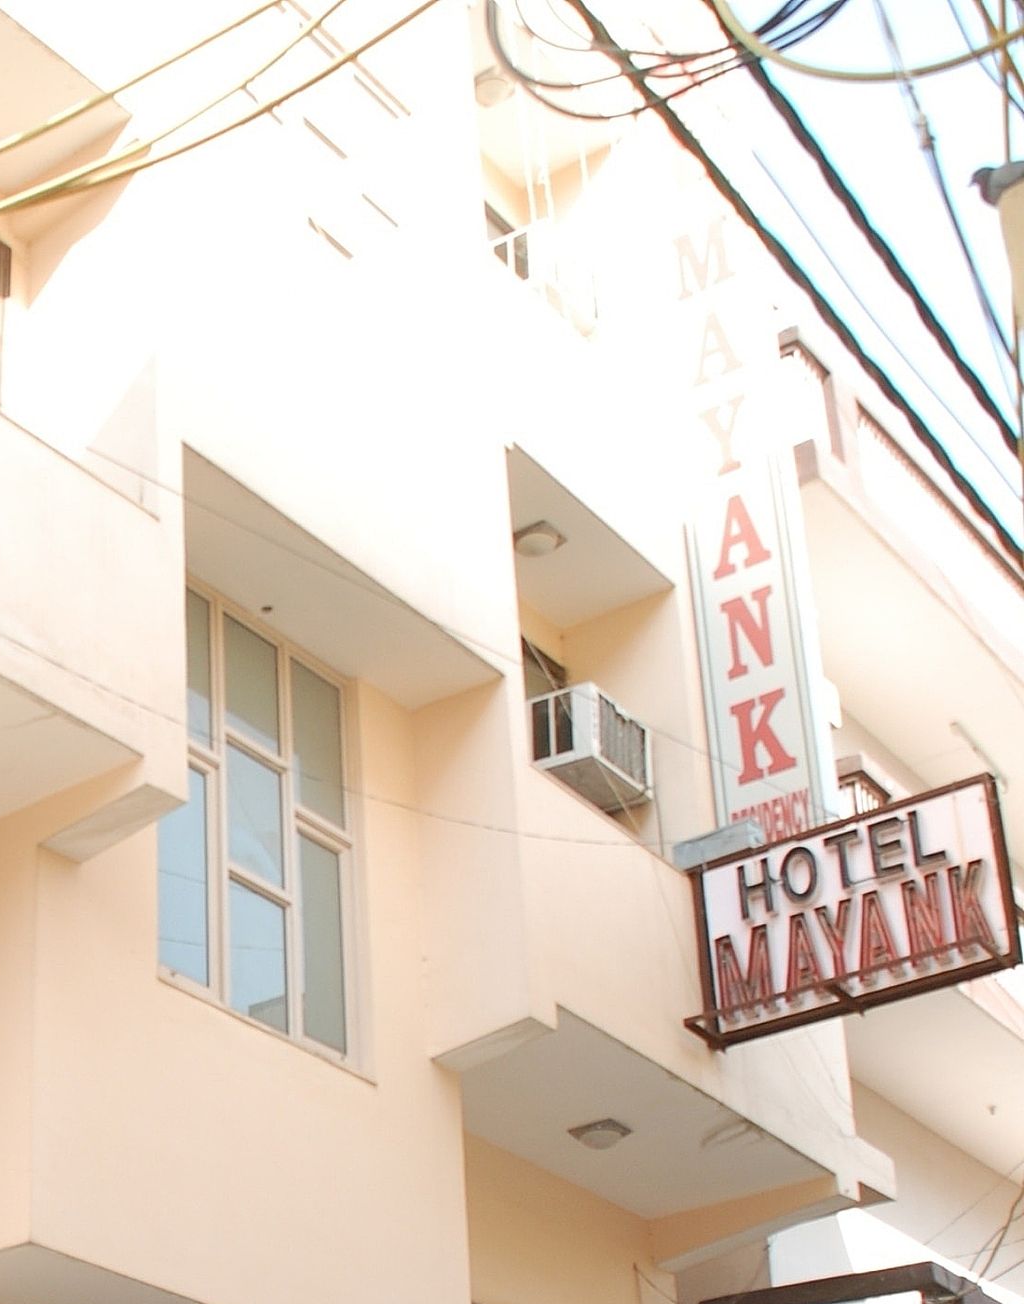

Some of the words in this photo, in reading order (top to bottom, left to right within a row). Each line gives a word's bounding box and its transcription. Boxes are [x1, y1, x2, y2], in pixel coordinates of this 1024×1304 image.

[673, 218, 797, 786] MAYANK
[714, 859, 996, 1016] MAYANK
[737, 811, 946, 920] HOTEL
